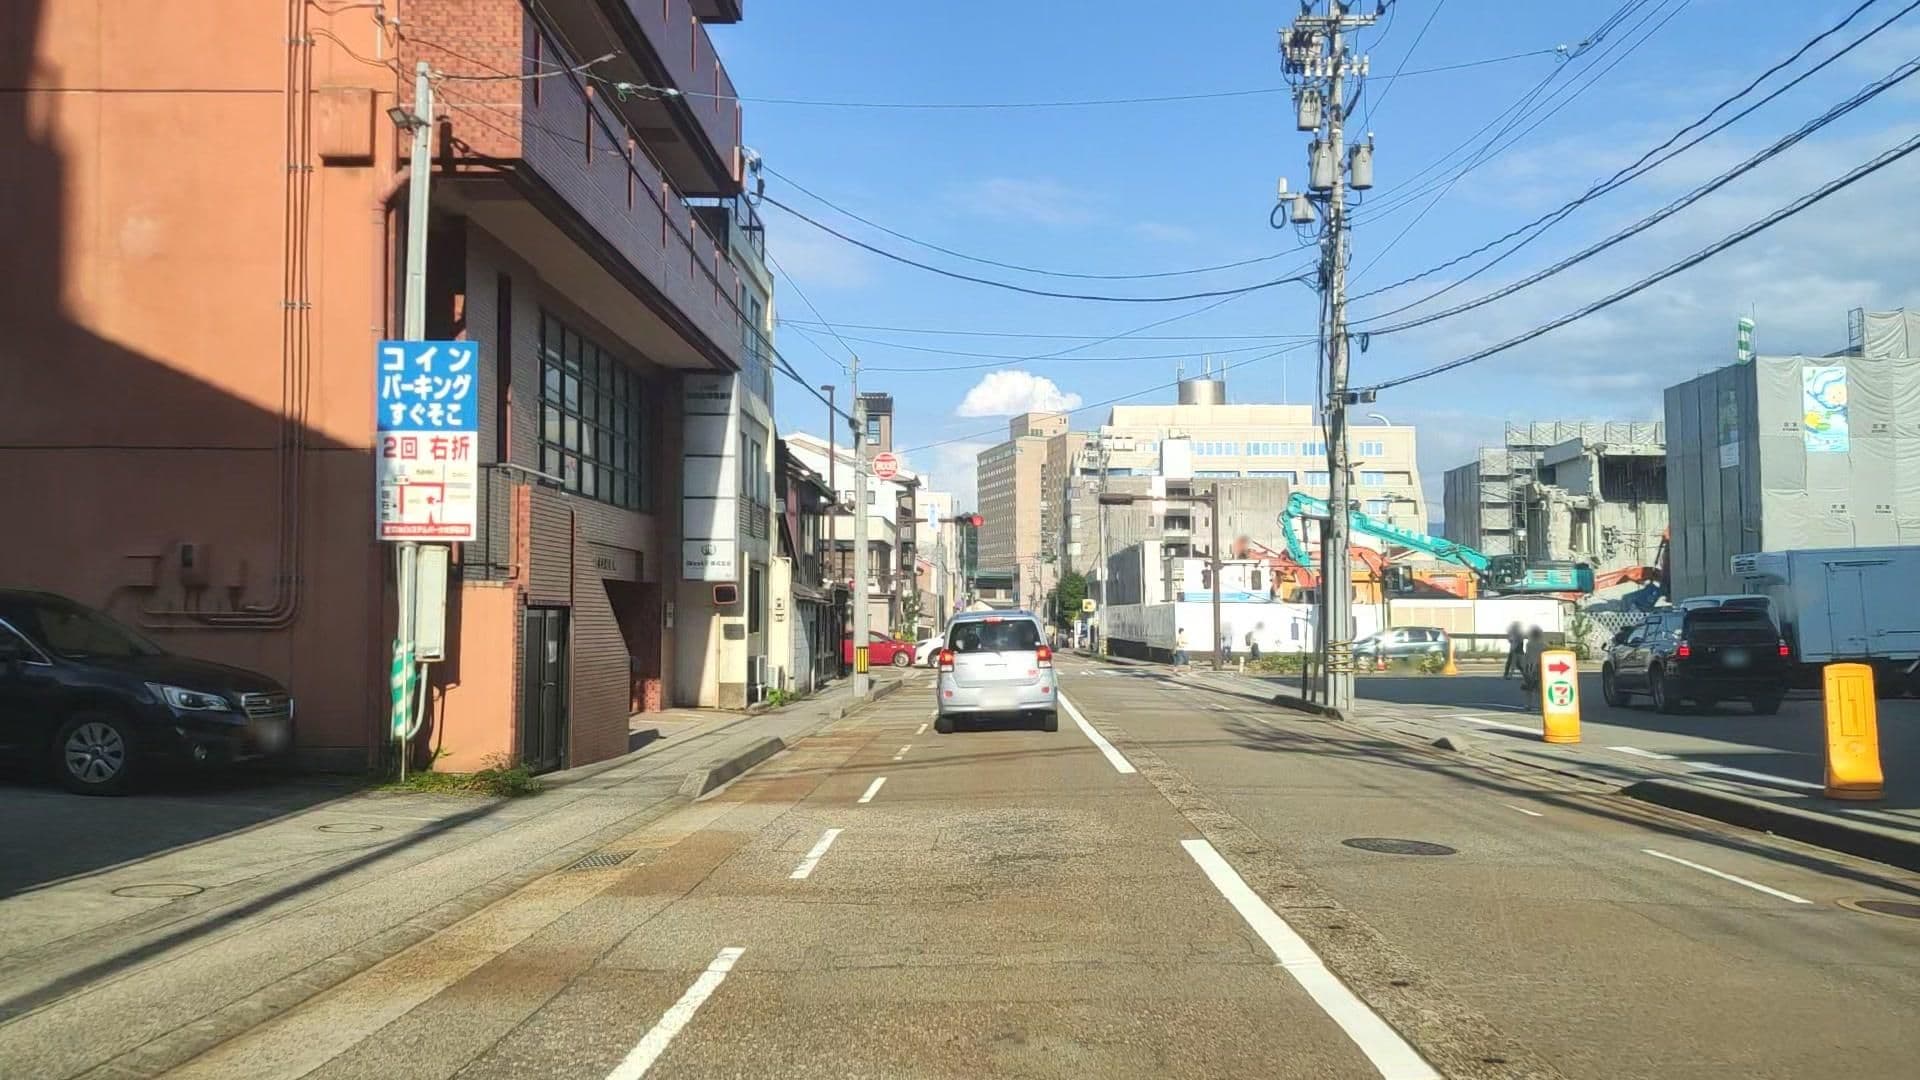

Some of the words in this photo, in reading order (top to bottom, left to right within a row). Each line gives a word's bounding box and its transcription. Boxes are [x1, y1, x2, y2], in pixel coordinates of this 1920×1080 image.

[384, 347, 471, 372] コイン
[382, 374, 472, 400] パーキング
[389, 402, 463, 426] すぐそこ
[430, 436, 470, 461] 右折
